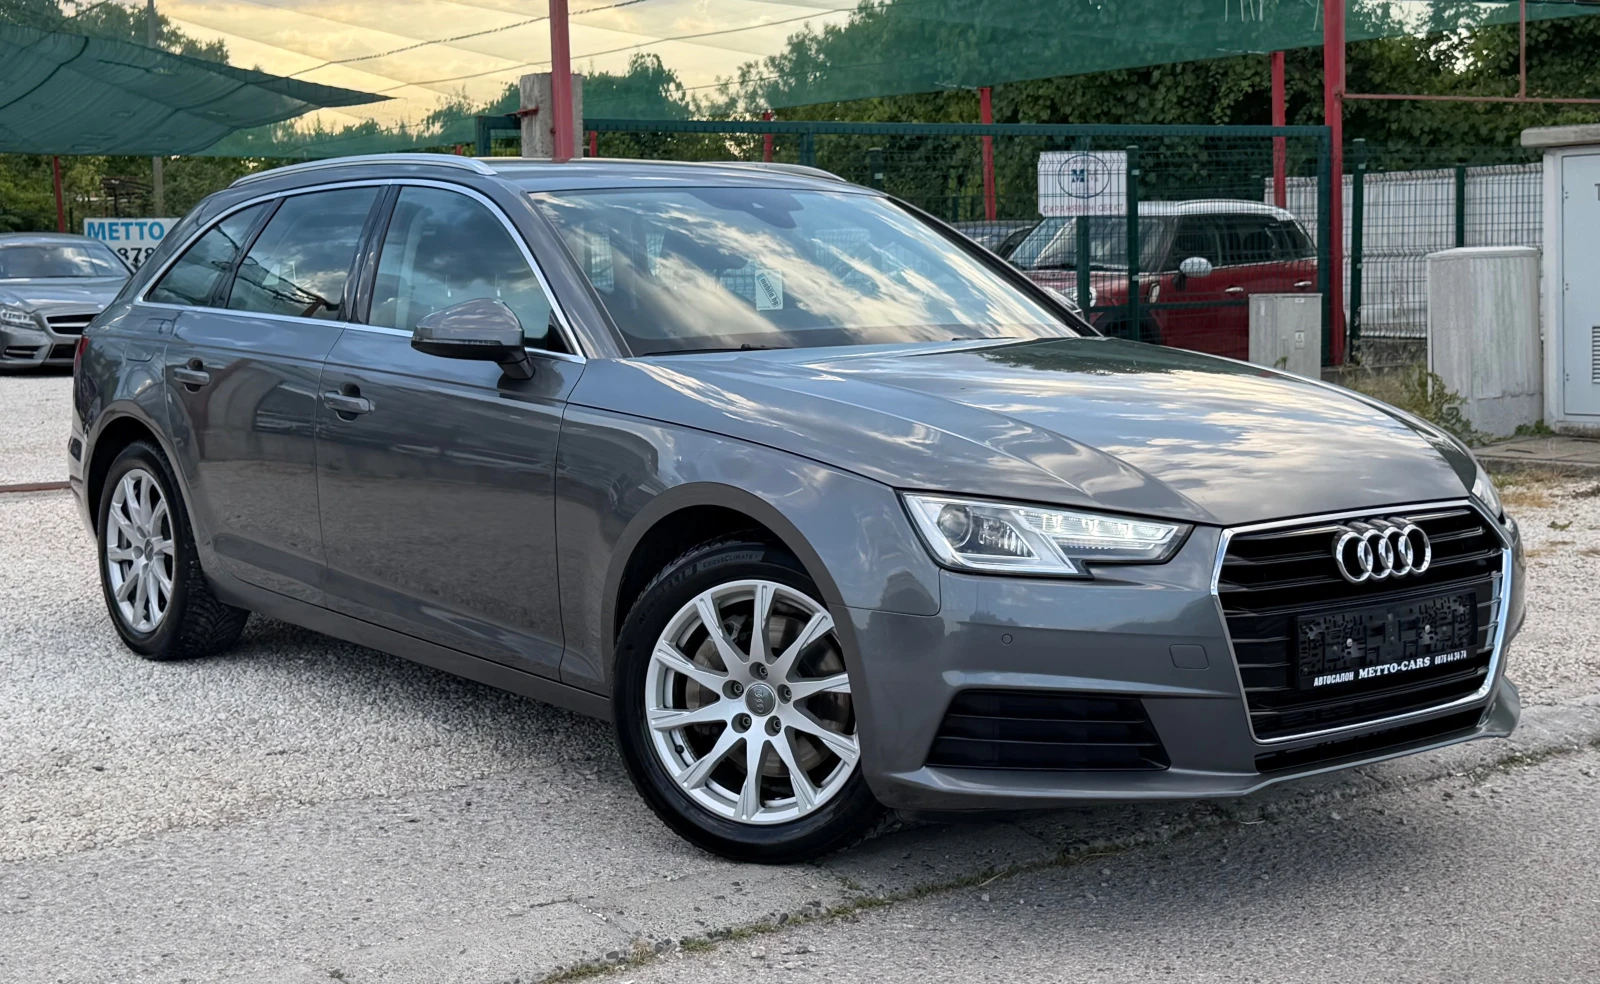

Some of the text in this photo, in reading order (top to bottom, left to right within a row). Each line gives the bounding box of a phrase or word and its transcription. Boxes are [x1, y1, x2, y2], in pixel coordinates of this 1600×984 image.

[87, 221, 165, 241] METTO
[1313, 671, 1354, 687] АВТОСАЛОН
[1358, 656, 1430, 680] METTO-CARS
